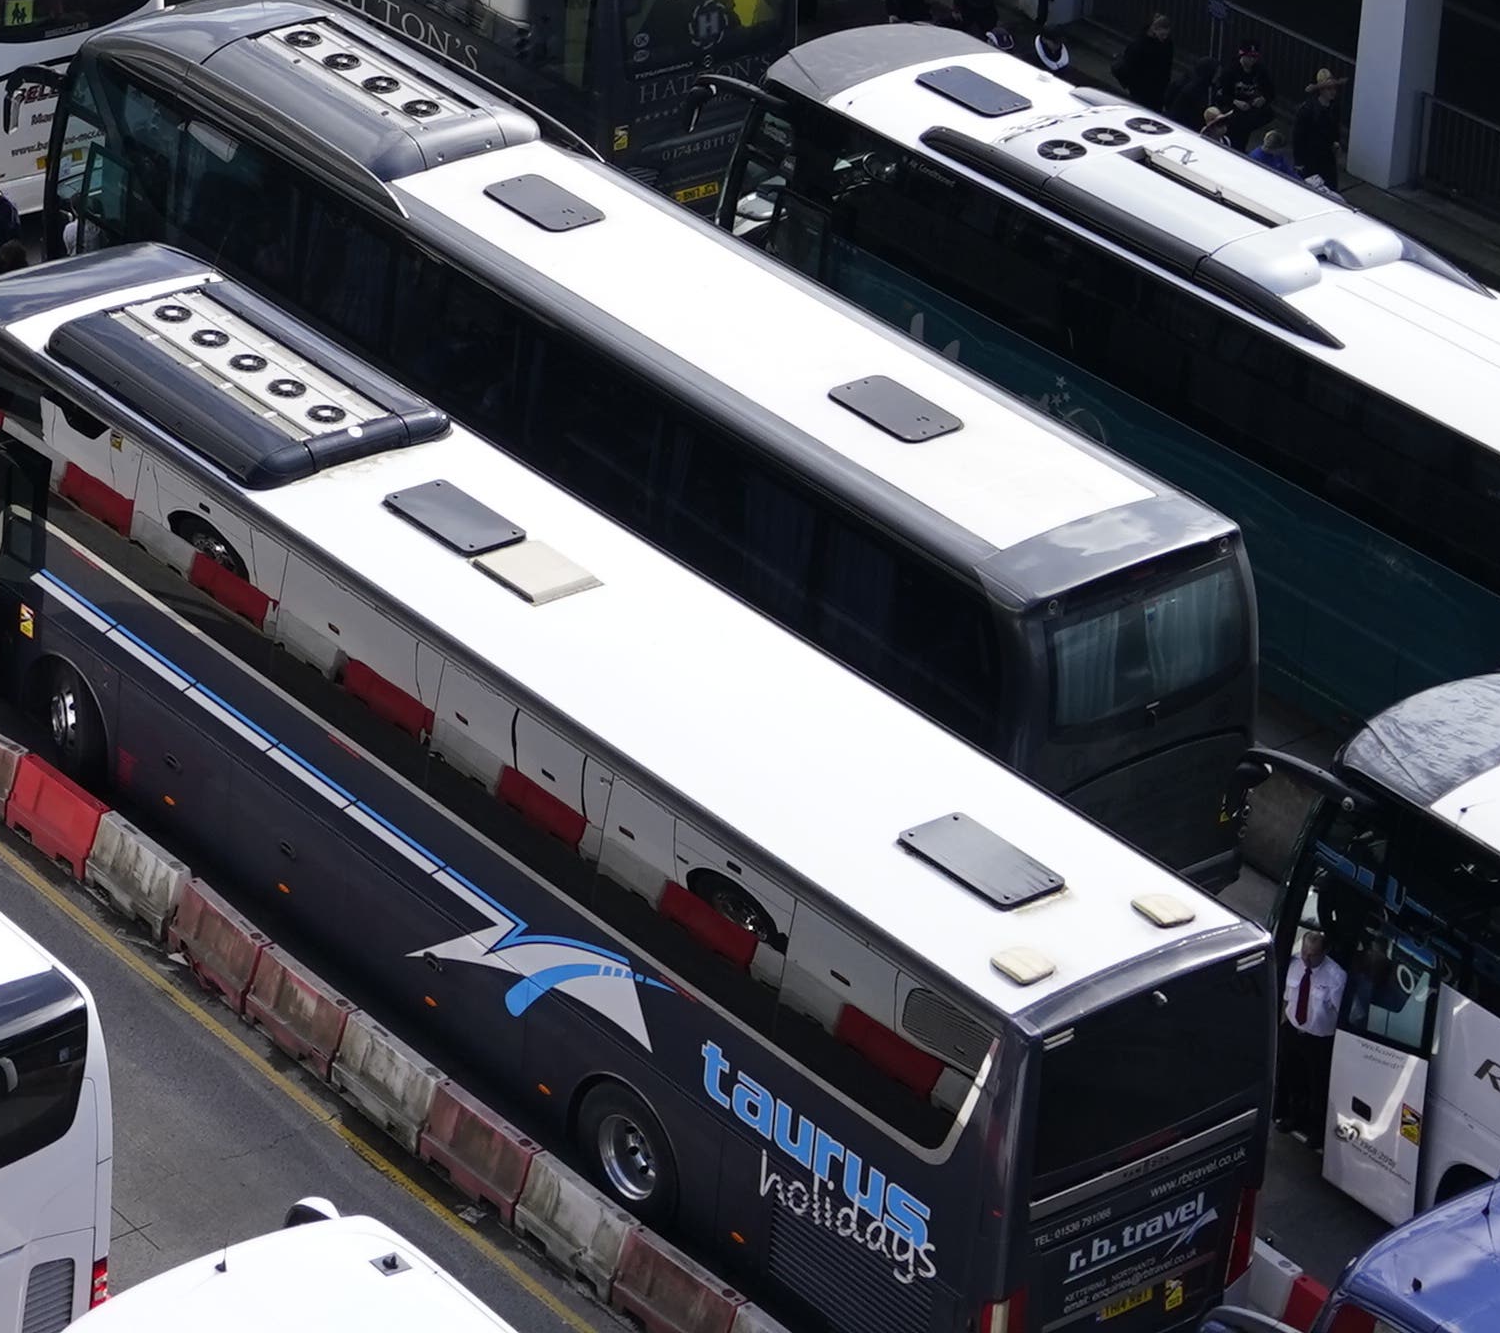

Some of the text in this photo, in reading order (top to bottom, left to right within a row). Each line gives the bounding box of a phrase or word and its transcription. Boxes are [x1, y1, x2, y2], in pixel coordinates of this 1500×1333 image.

[700, 1039, 931, 1250] taurus
[1150, 1145, 1247, 1198] www.rbtravel.co.uk
[758, 1148, 938, 1285] holidays
[1033, 1233, 1053, 1247] TEL:
[1121, 1192, 1204, 1249] travel
